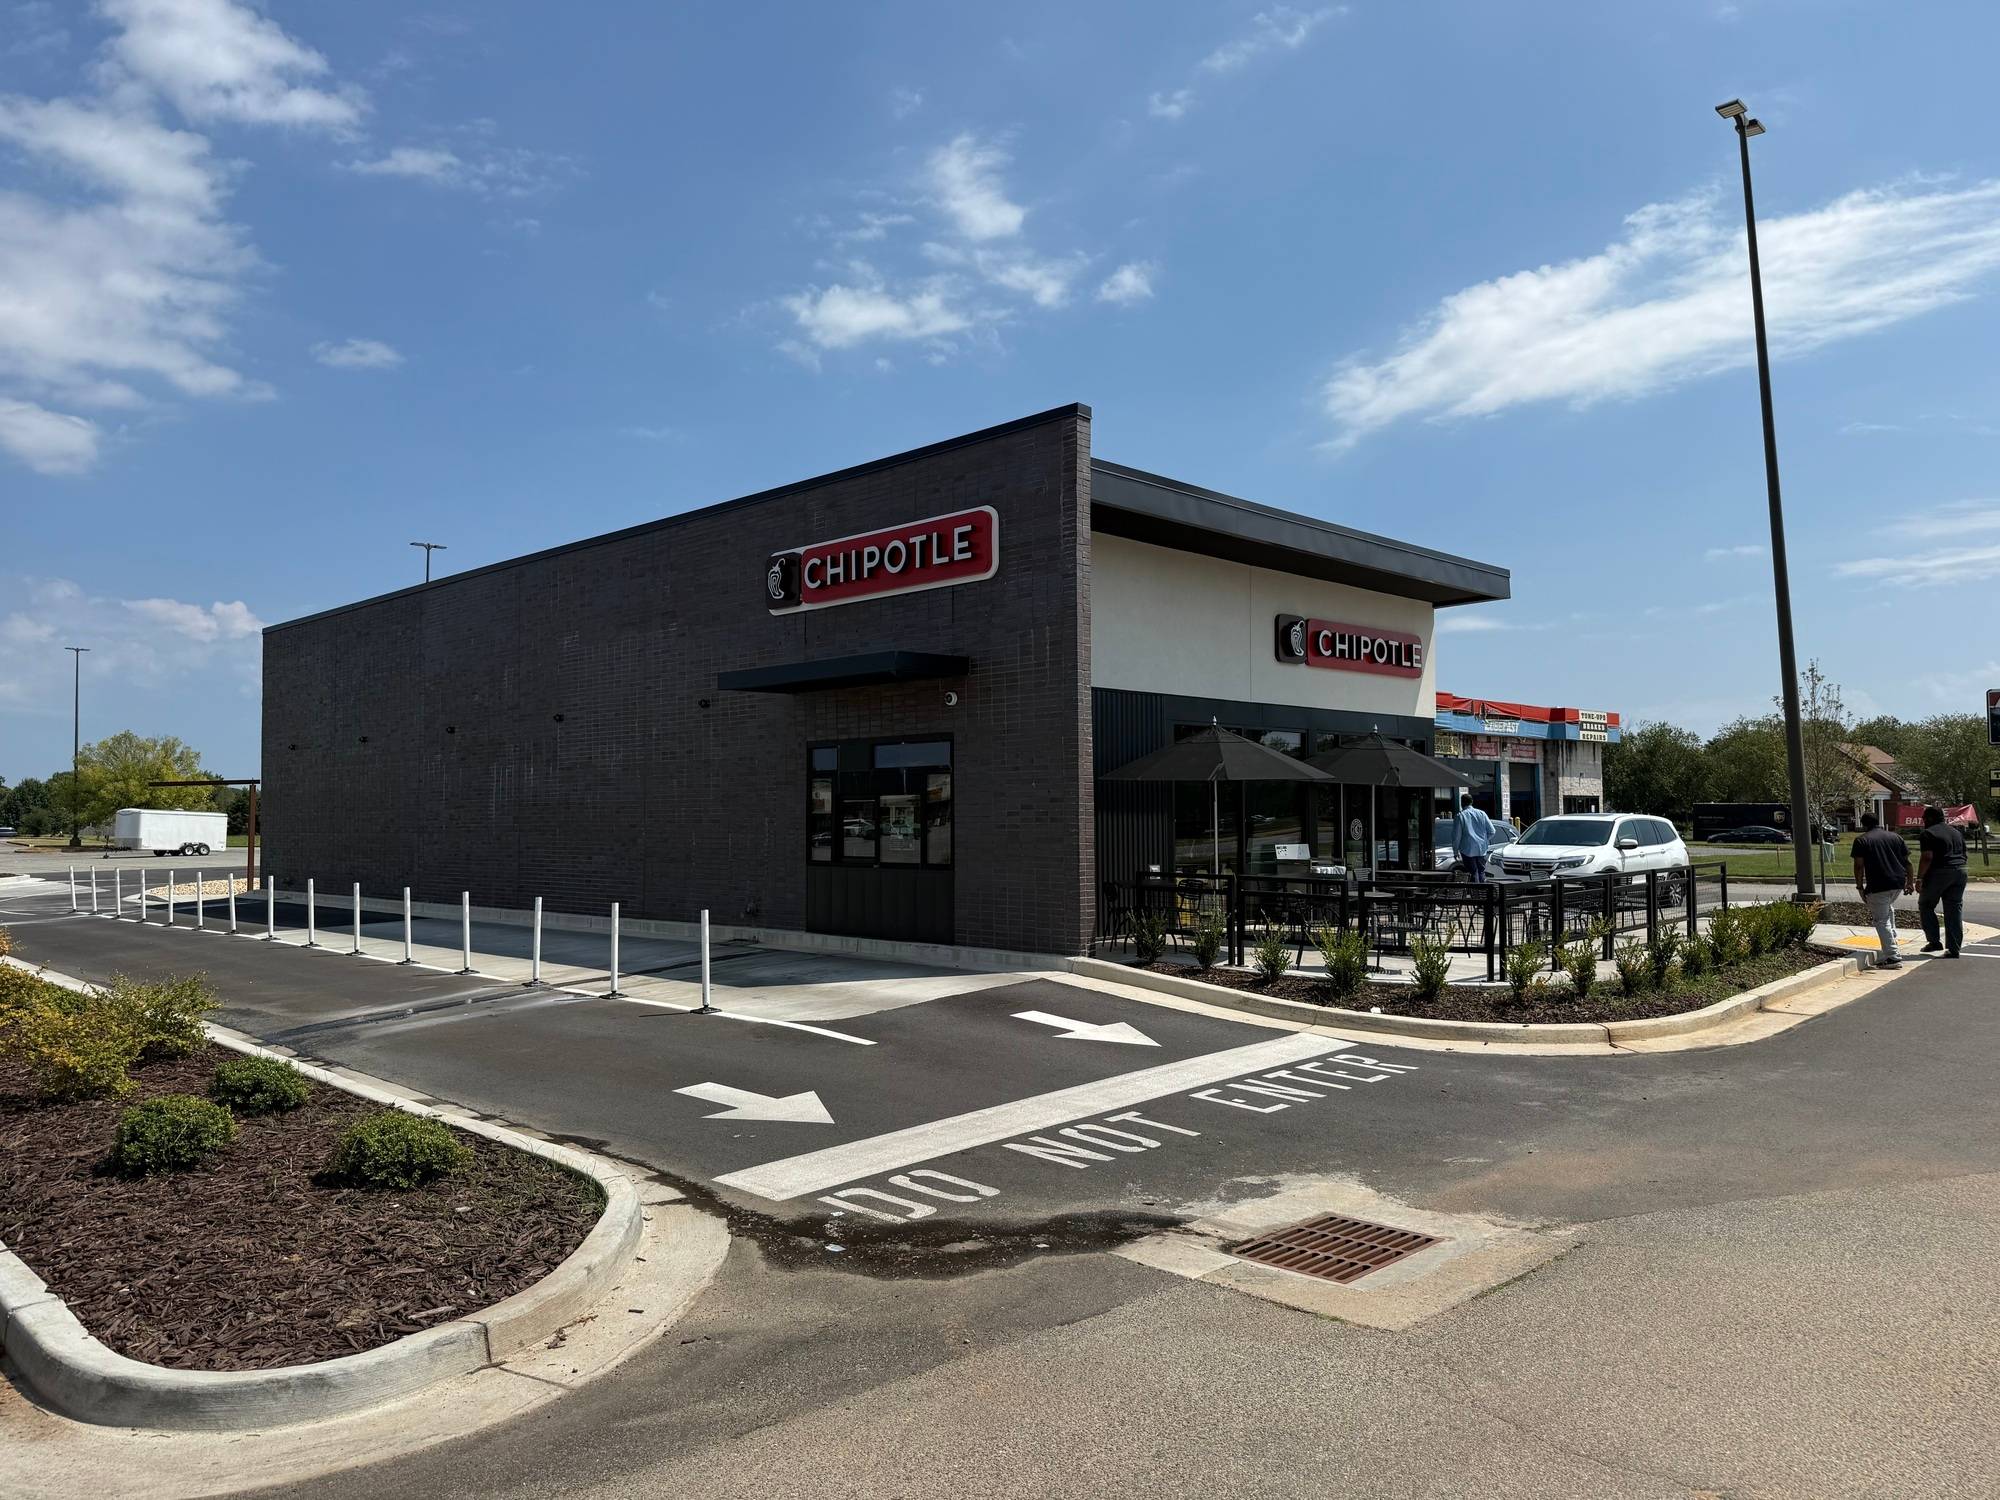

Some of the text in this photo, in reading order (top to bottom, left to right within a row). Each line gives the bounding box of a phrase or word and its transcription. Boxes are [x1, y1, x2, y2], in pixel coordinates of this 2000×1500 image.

[804, 525, 972, 589] CHIPOTLE
[1319, 629, 1422, 668] CHIPOTLE
[1581, 712, 1606, 721] TUNE-UPS
[1582, 723, 1605, 731] BRAKES
[1582, 733, 1606, 741] REPAIRS
[817, 1054, 1419, 1224] DO NOT ENTER
